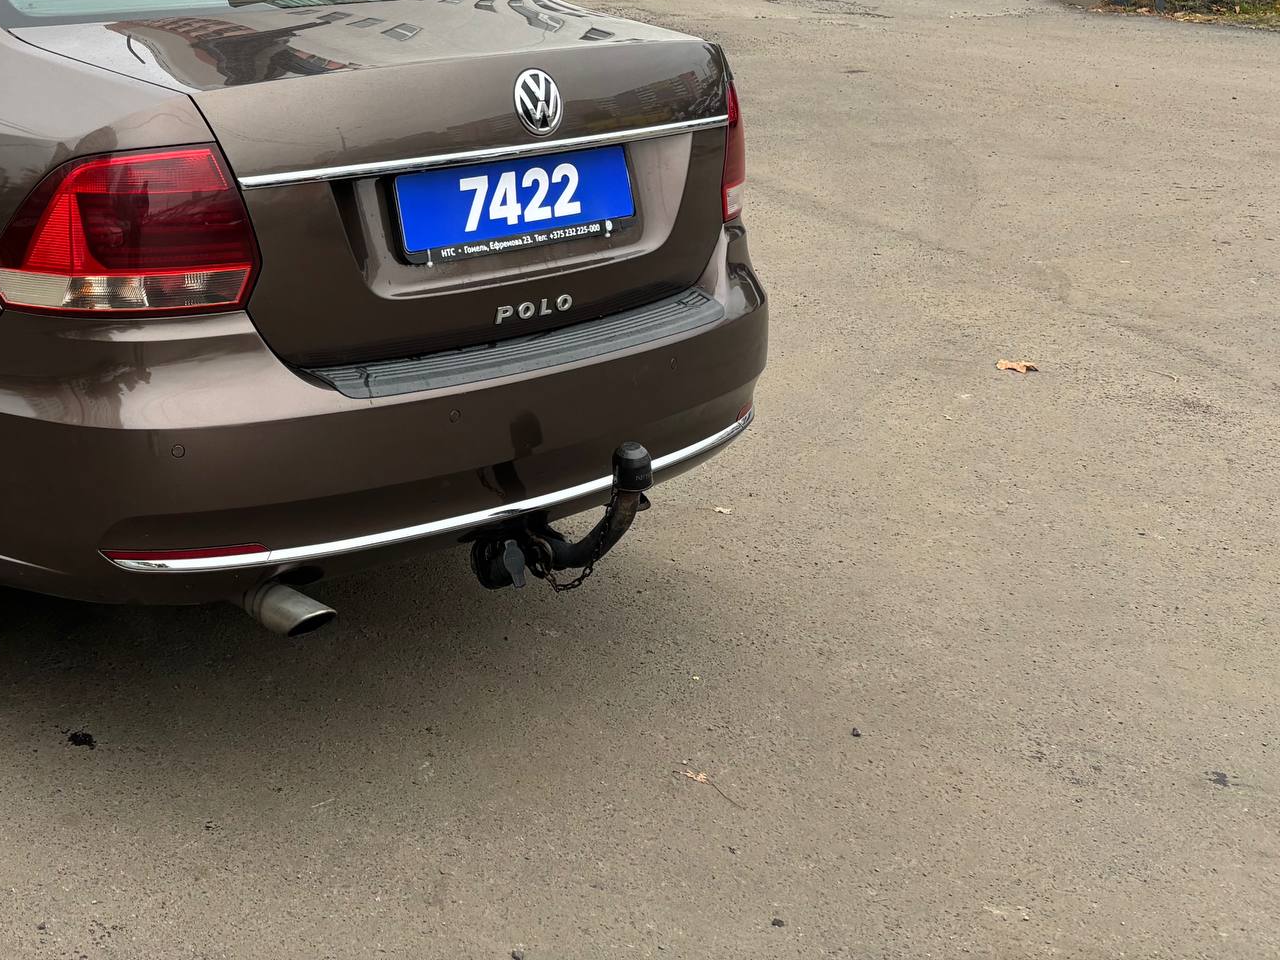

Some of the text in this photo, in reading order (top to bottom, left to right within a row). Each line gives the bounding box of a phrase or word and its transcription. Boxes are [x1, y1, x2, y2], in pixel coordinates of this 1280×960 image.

[459, 162, 582, 232] 7422
[549, 229, 565, 240] +375
[565, 228, 577, 237] 232
[495, 294, 573, 325] POLO
